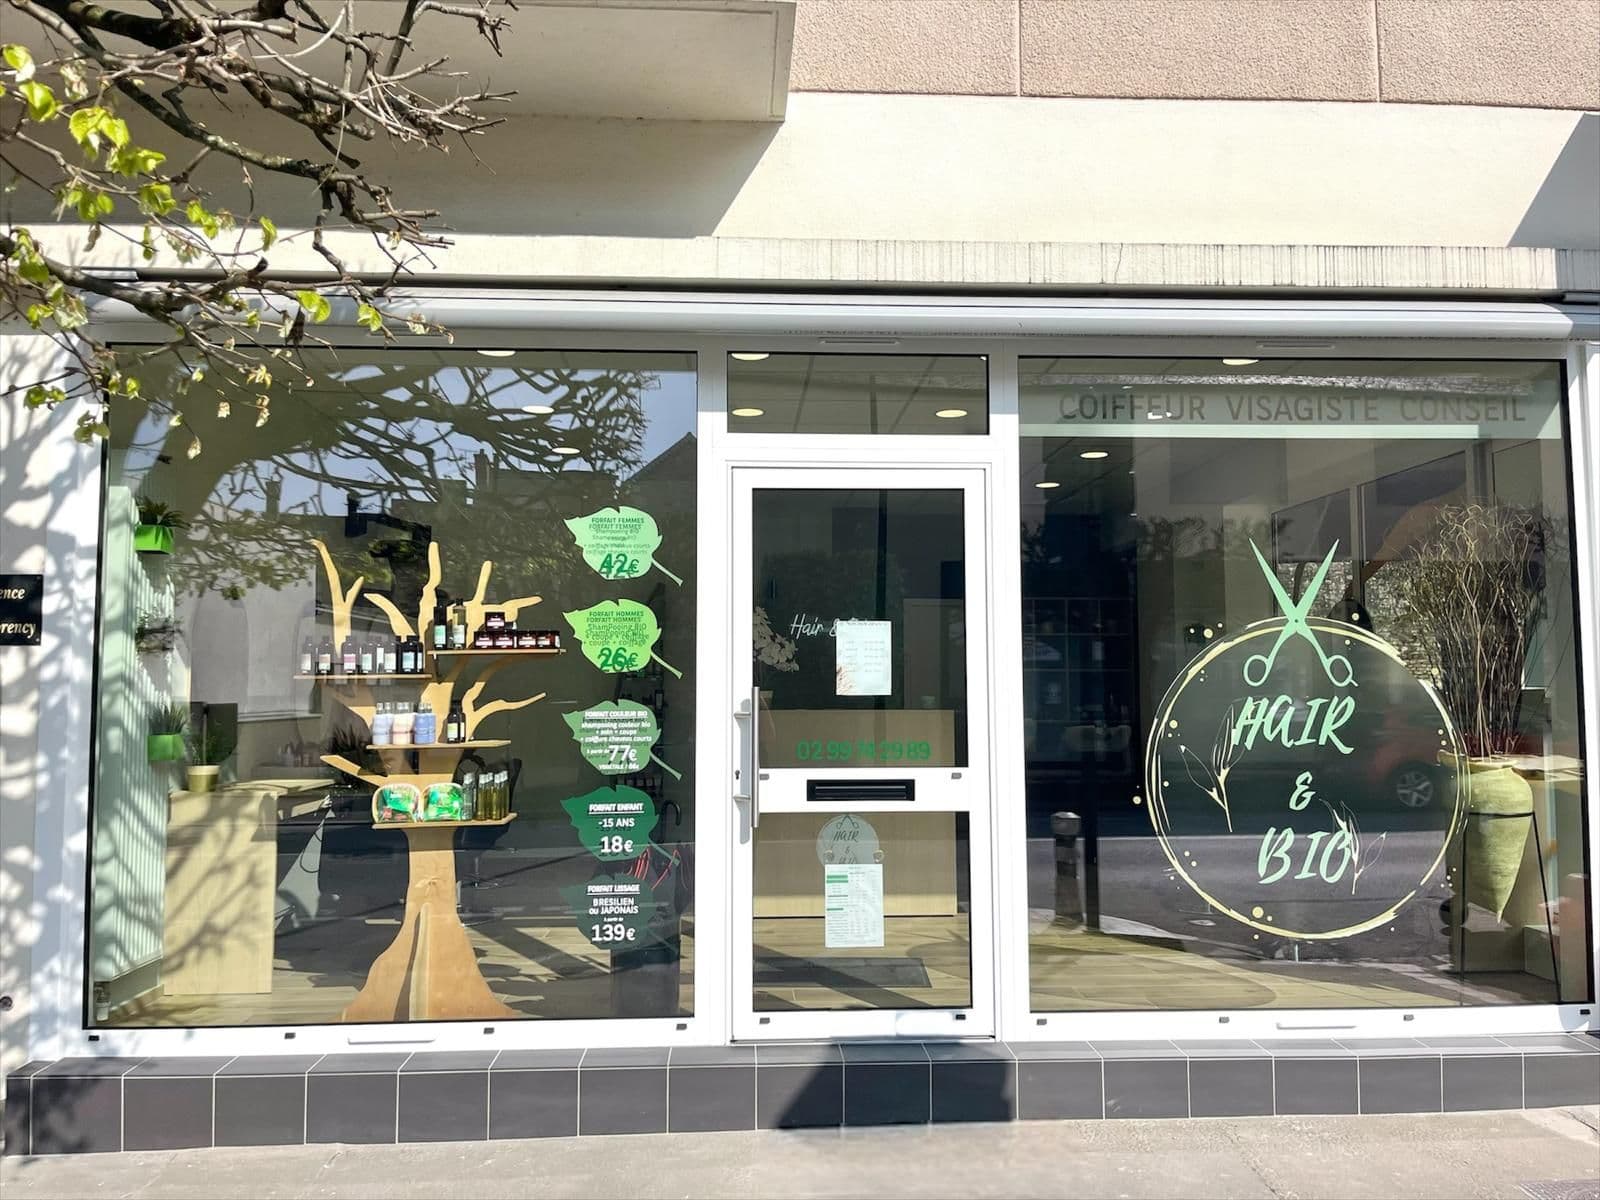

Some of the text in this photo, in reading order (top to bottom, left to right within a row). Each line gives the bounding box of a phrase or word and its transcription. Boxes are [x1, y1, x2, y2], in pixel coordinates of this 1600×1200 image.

[1059, 394, 1526, 422] COIFFEUR VISAGISTE CONSEIL
[790, 613, 824, 639] Hair
[1233, 695, 1355, 754] HAIR
[608, 745, 637, 762] 77€
[797, 740, 823, 760] 02
[827, 740, 852, 760] 99
[1289, 771, 1315, 810] &
[589, 802, 644, 812] FORFAIT ENFANT
[598, 817, 635, 827] -15 ANS
[600, 835, 634, 853] 18€
[1258, 827, 1353, 884] BIO
[587, 885, 613, 893] FORFAIT
[600, 905, 639, 914] JAPONAIS
[591, 923, 636, 942] 139€
